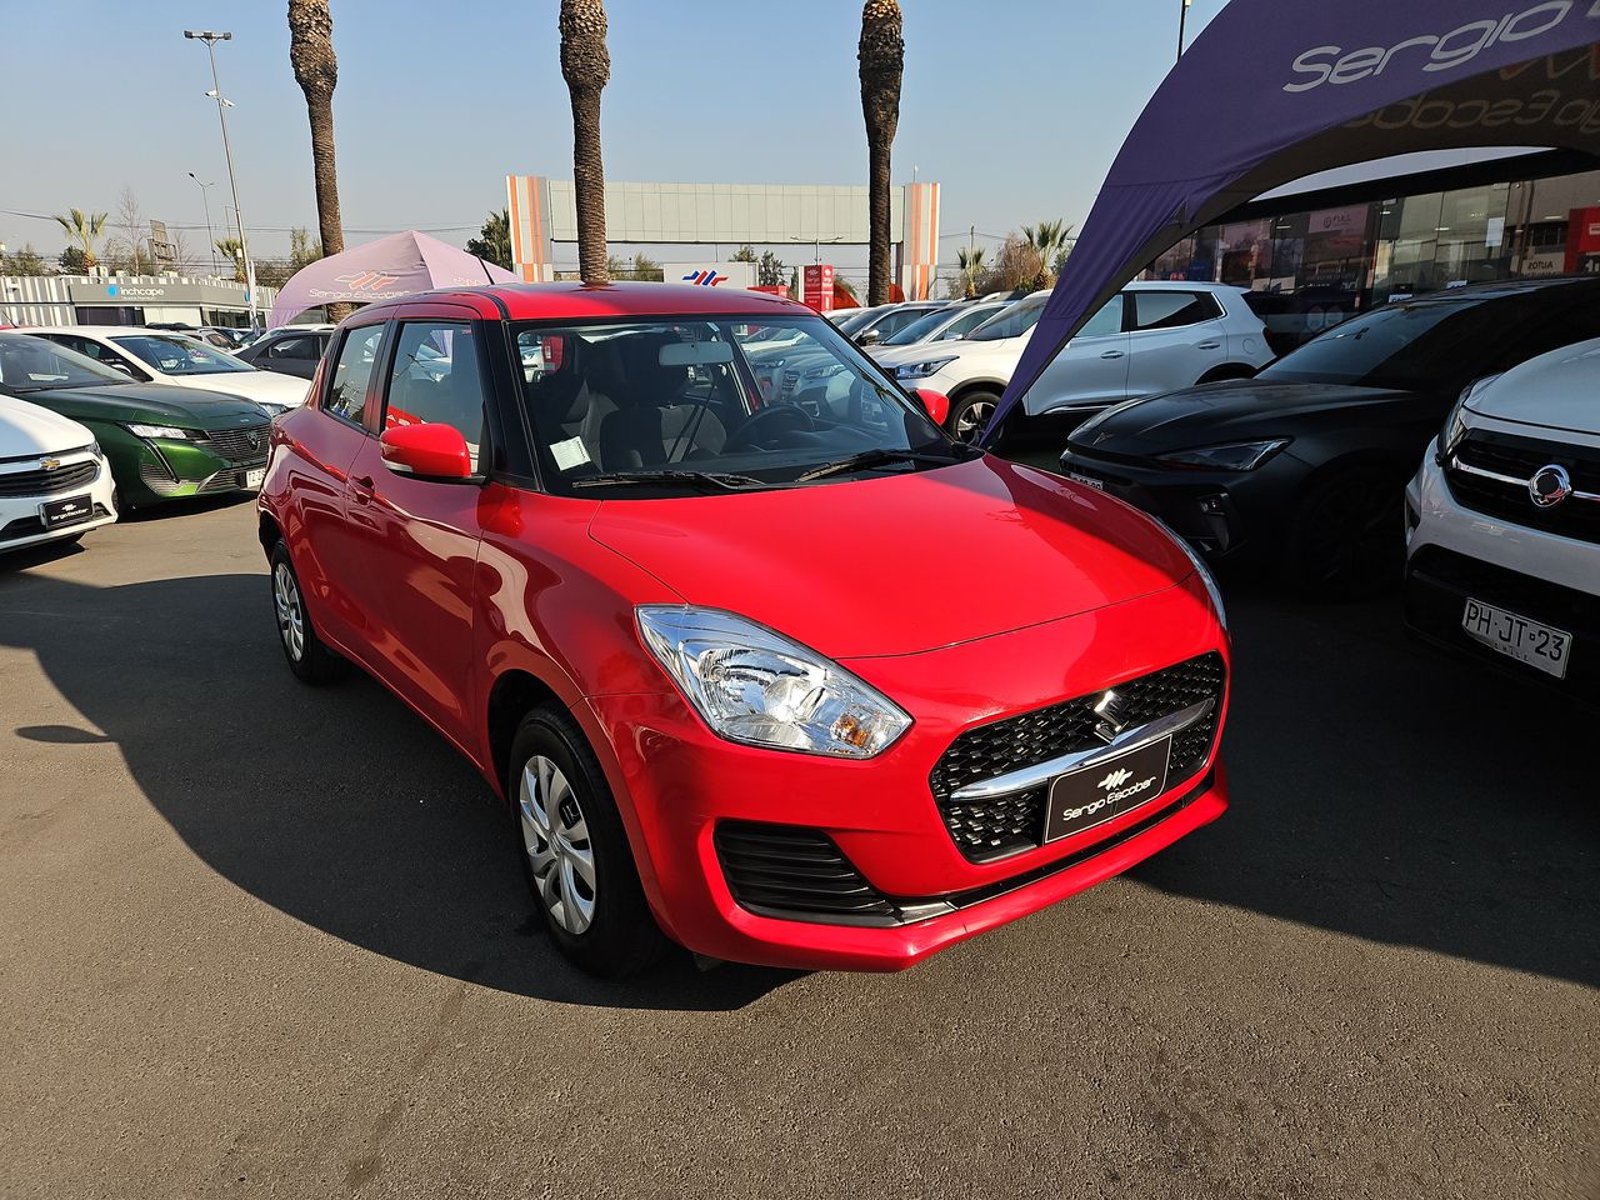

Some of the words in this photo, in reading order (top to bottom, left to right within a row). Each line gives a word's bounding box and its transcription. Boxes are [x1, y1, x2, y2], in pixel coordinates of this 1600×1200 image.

[1282, 0, 1574, 92] Sergio
[120, 287, 165, 297] inchcape
[1063, 799, 1106, 821] Sergio
[1106, 776, 1157, 805] Escobar
